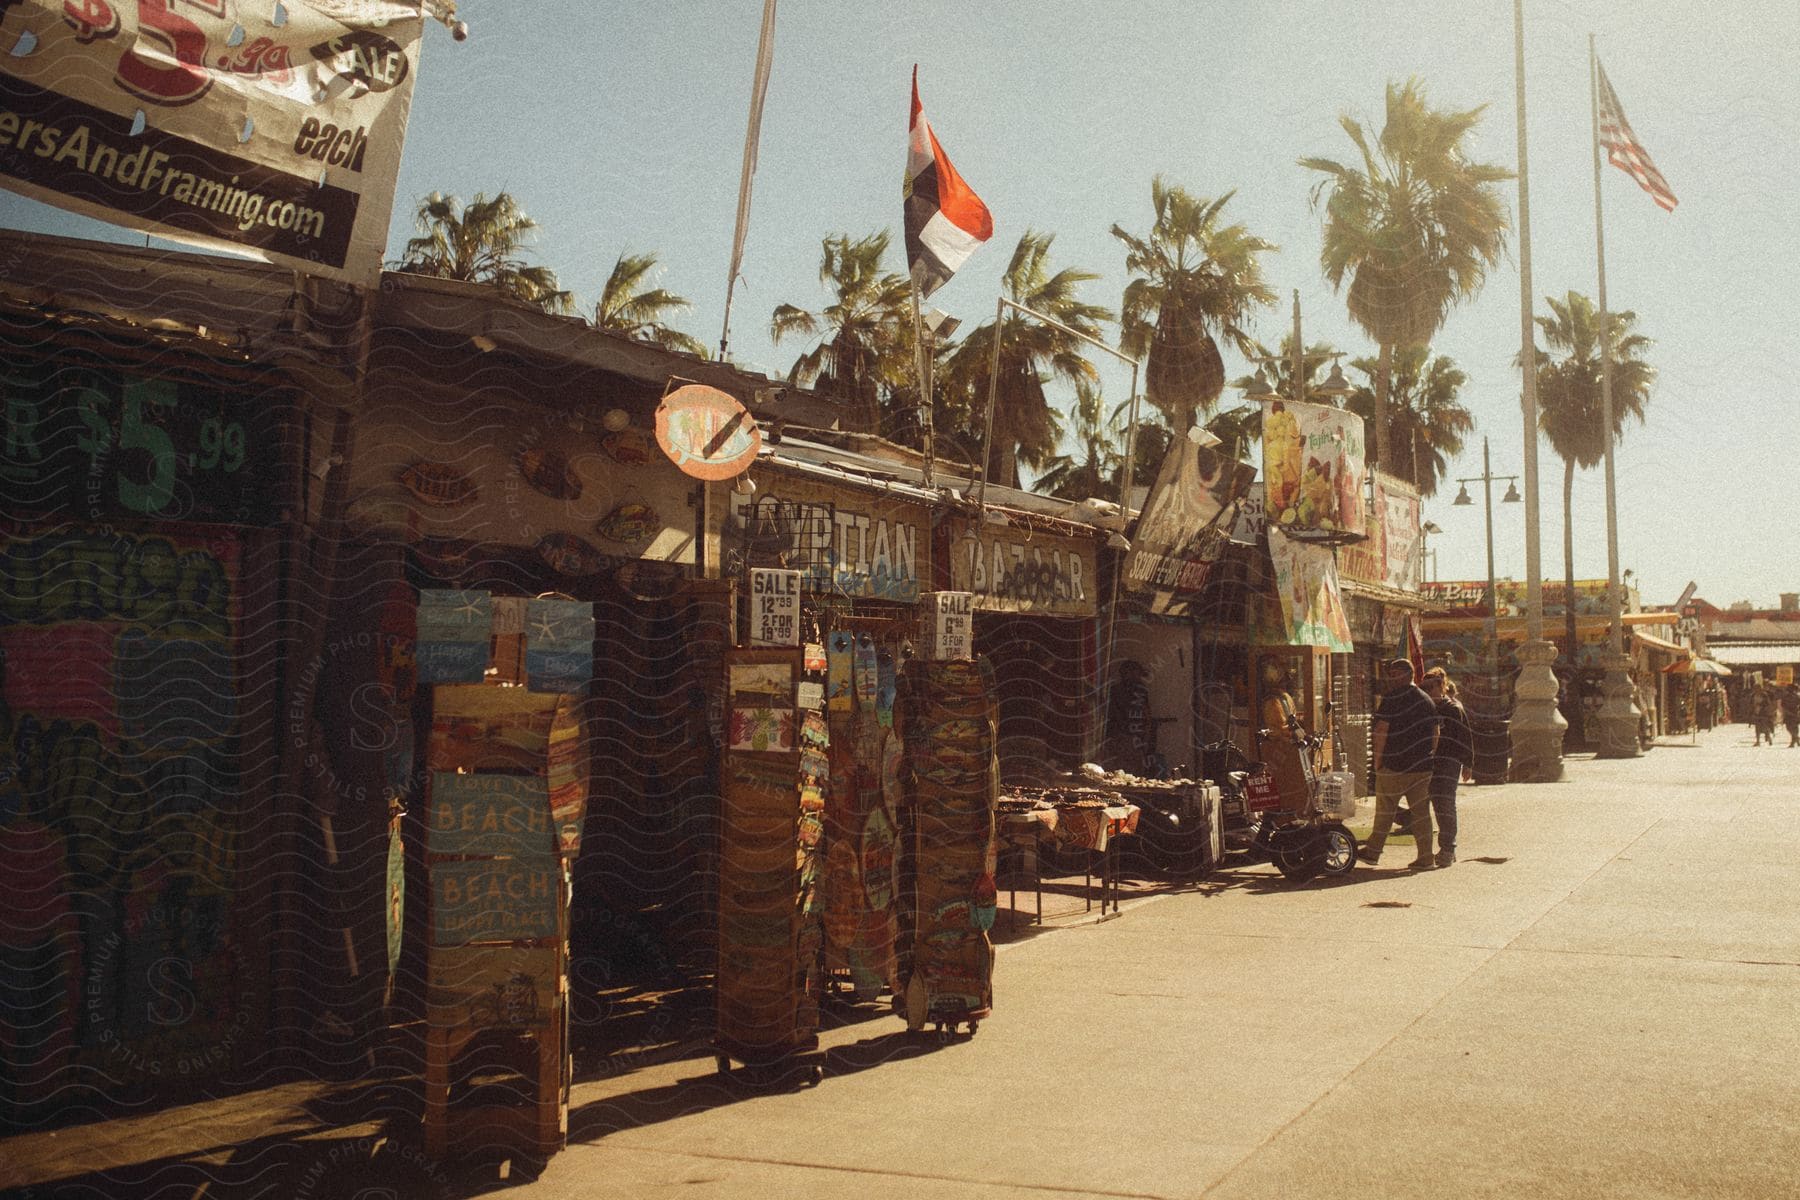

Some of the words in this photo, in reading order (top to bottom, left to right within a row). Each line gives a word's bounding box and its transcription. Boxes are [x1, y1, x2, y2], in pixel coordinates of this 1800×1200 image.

[328, 37, 400, 85] SALE
[294, 116, 368, 172] each
[754, 572, 797, 595] SALE
[941, 595, 971, 615] SALE
[762, 614, 769, 627] 2
[771, 614, 793, 628] FOR
[949, 636, 963, 647] FOR
[1248, 776, 1272, 787] RENT
[1256, 785, 1270, 794] ME
[437, 801, 547, 833] BEACH
[443, 871, 548, 903] BEACH
